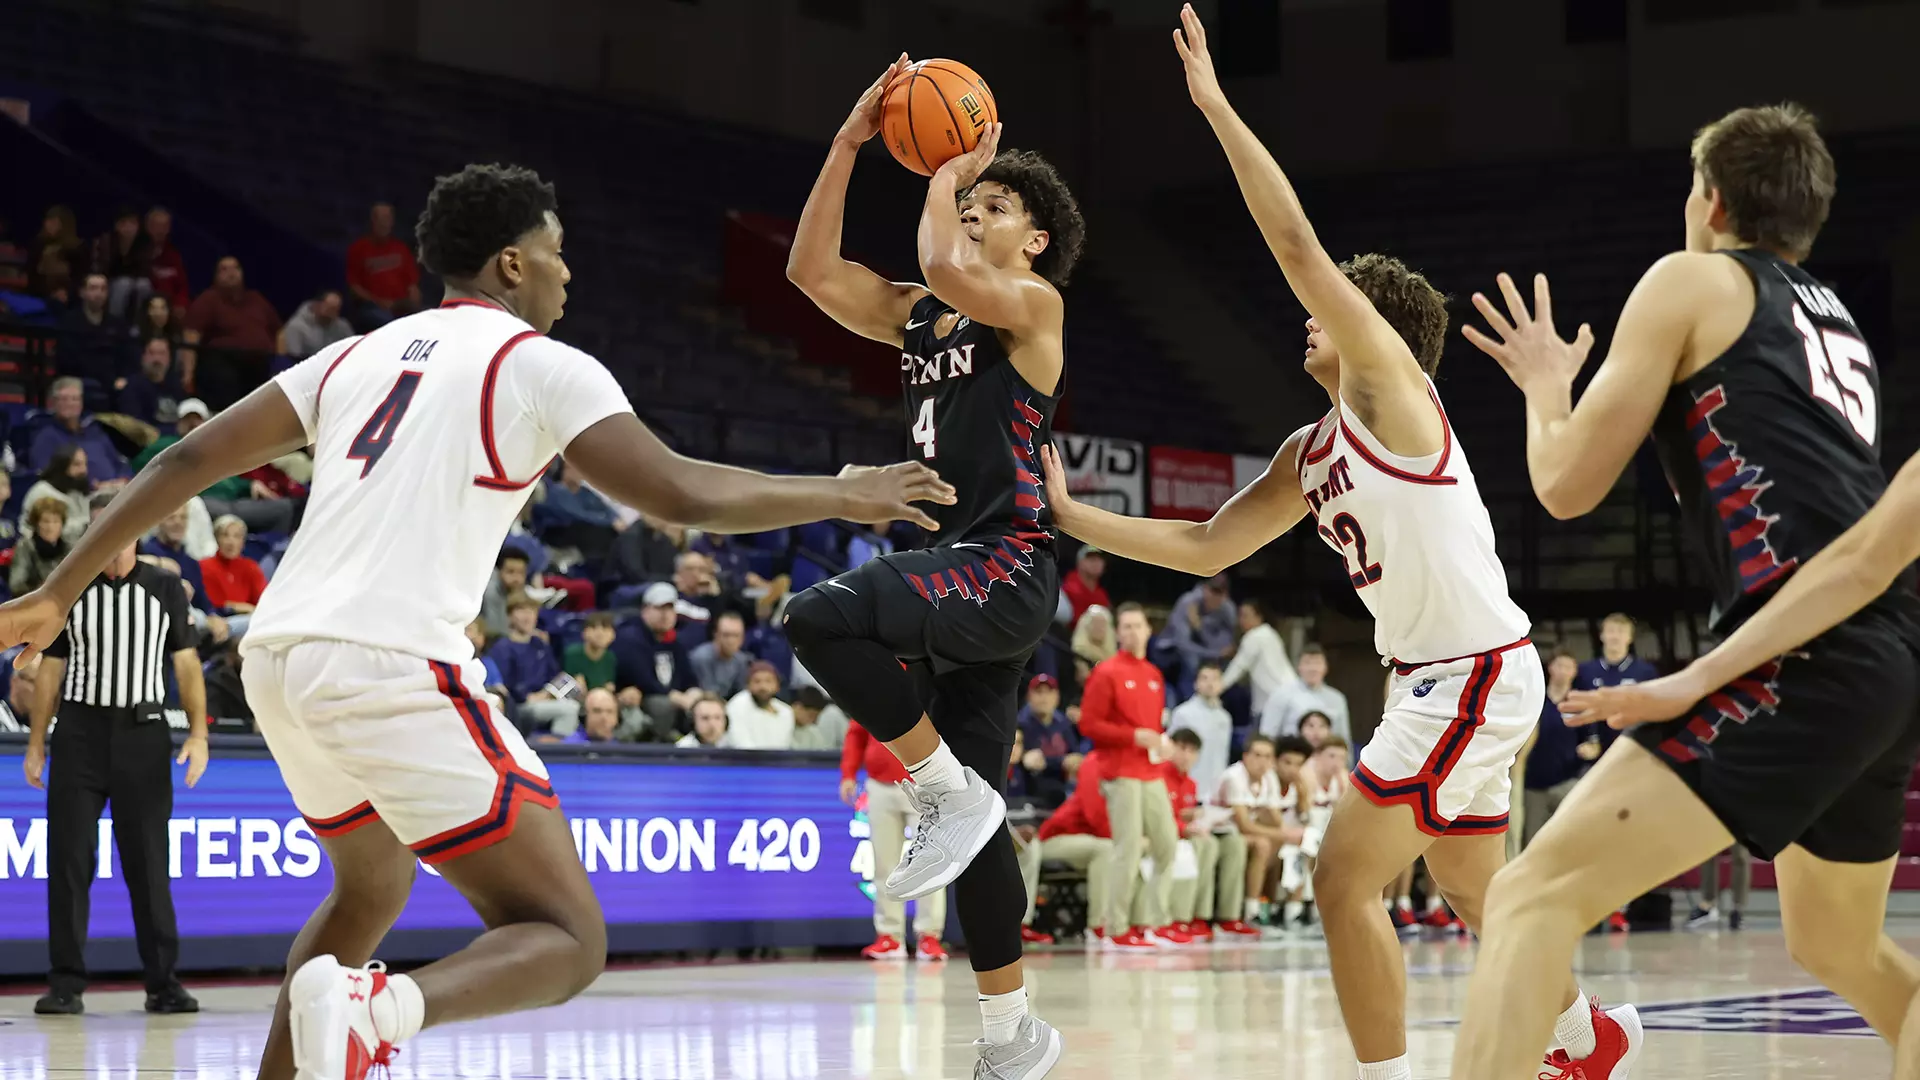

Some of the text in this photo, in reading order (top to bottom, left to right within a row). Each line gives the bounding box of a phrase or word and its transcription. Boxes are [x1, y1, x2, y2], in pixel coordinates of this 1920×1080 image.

[401, 339, 439, 362] DIA
[346, 370, 424, 480] 4
[912, 396, 936, 460] 4
[570, 817, 716, 873] NION
[728, 817, 821, 873] 420
